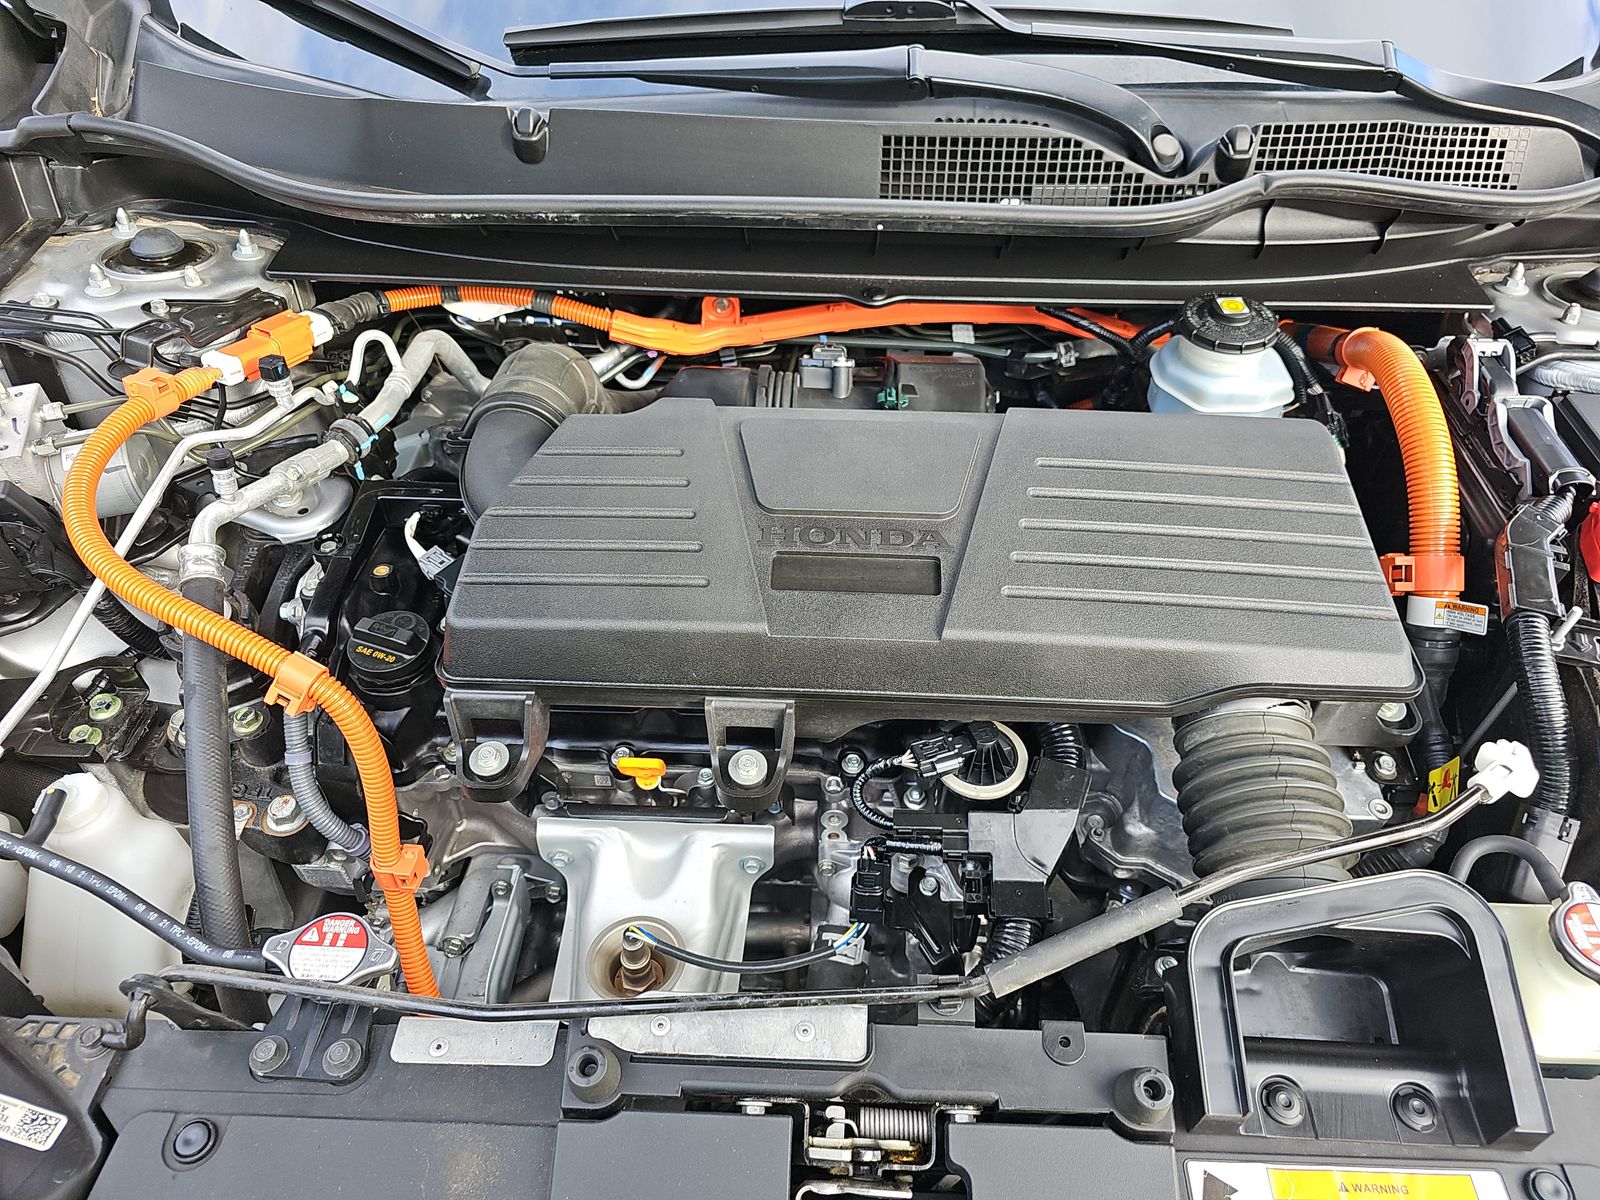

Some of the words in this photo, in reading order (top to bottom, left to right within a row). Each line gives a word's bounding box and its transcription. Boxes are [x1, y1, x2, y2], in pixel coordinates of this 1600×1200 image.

[757, 526, 954, 550] HONDA
[1452, 603, 1480, 614] WARNING
[355, 645, 373, 656] SAE
[372, 651, 396, 663] 0W-20
[323, 918, 356, 928] DANGER
[169, 925, 185, 938] TPC
[1352, 1183, 1409, 1196] WARNING
